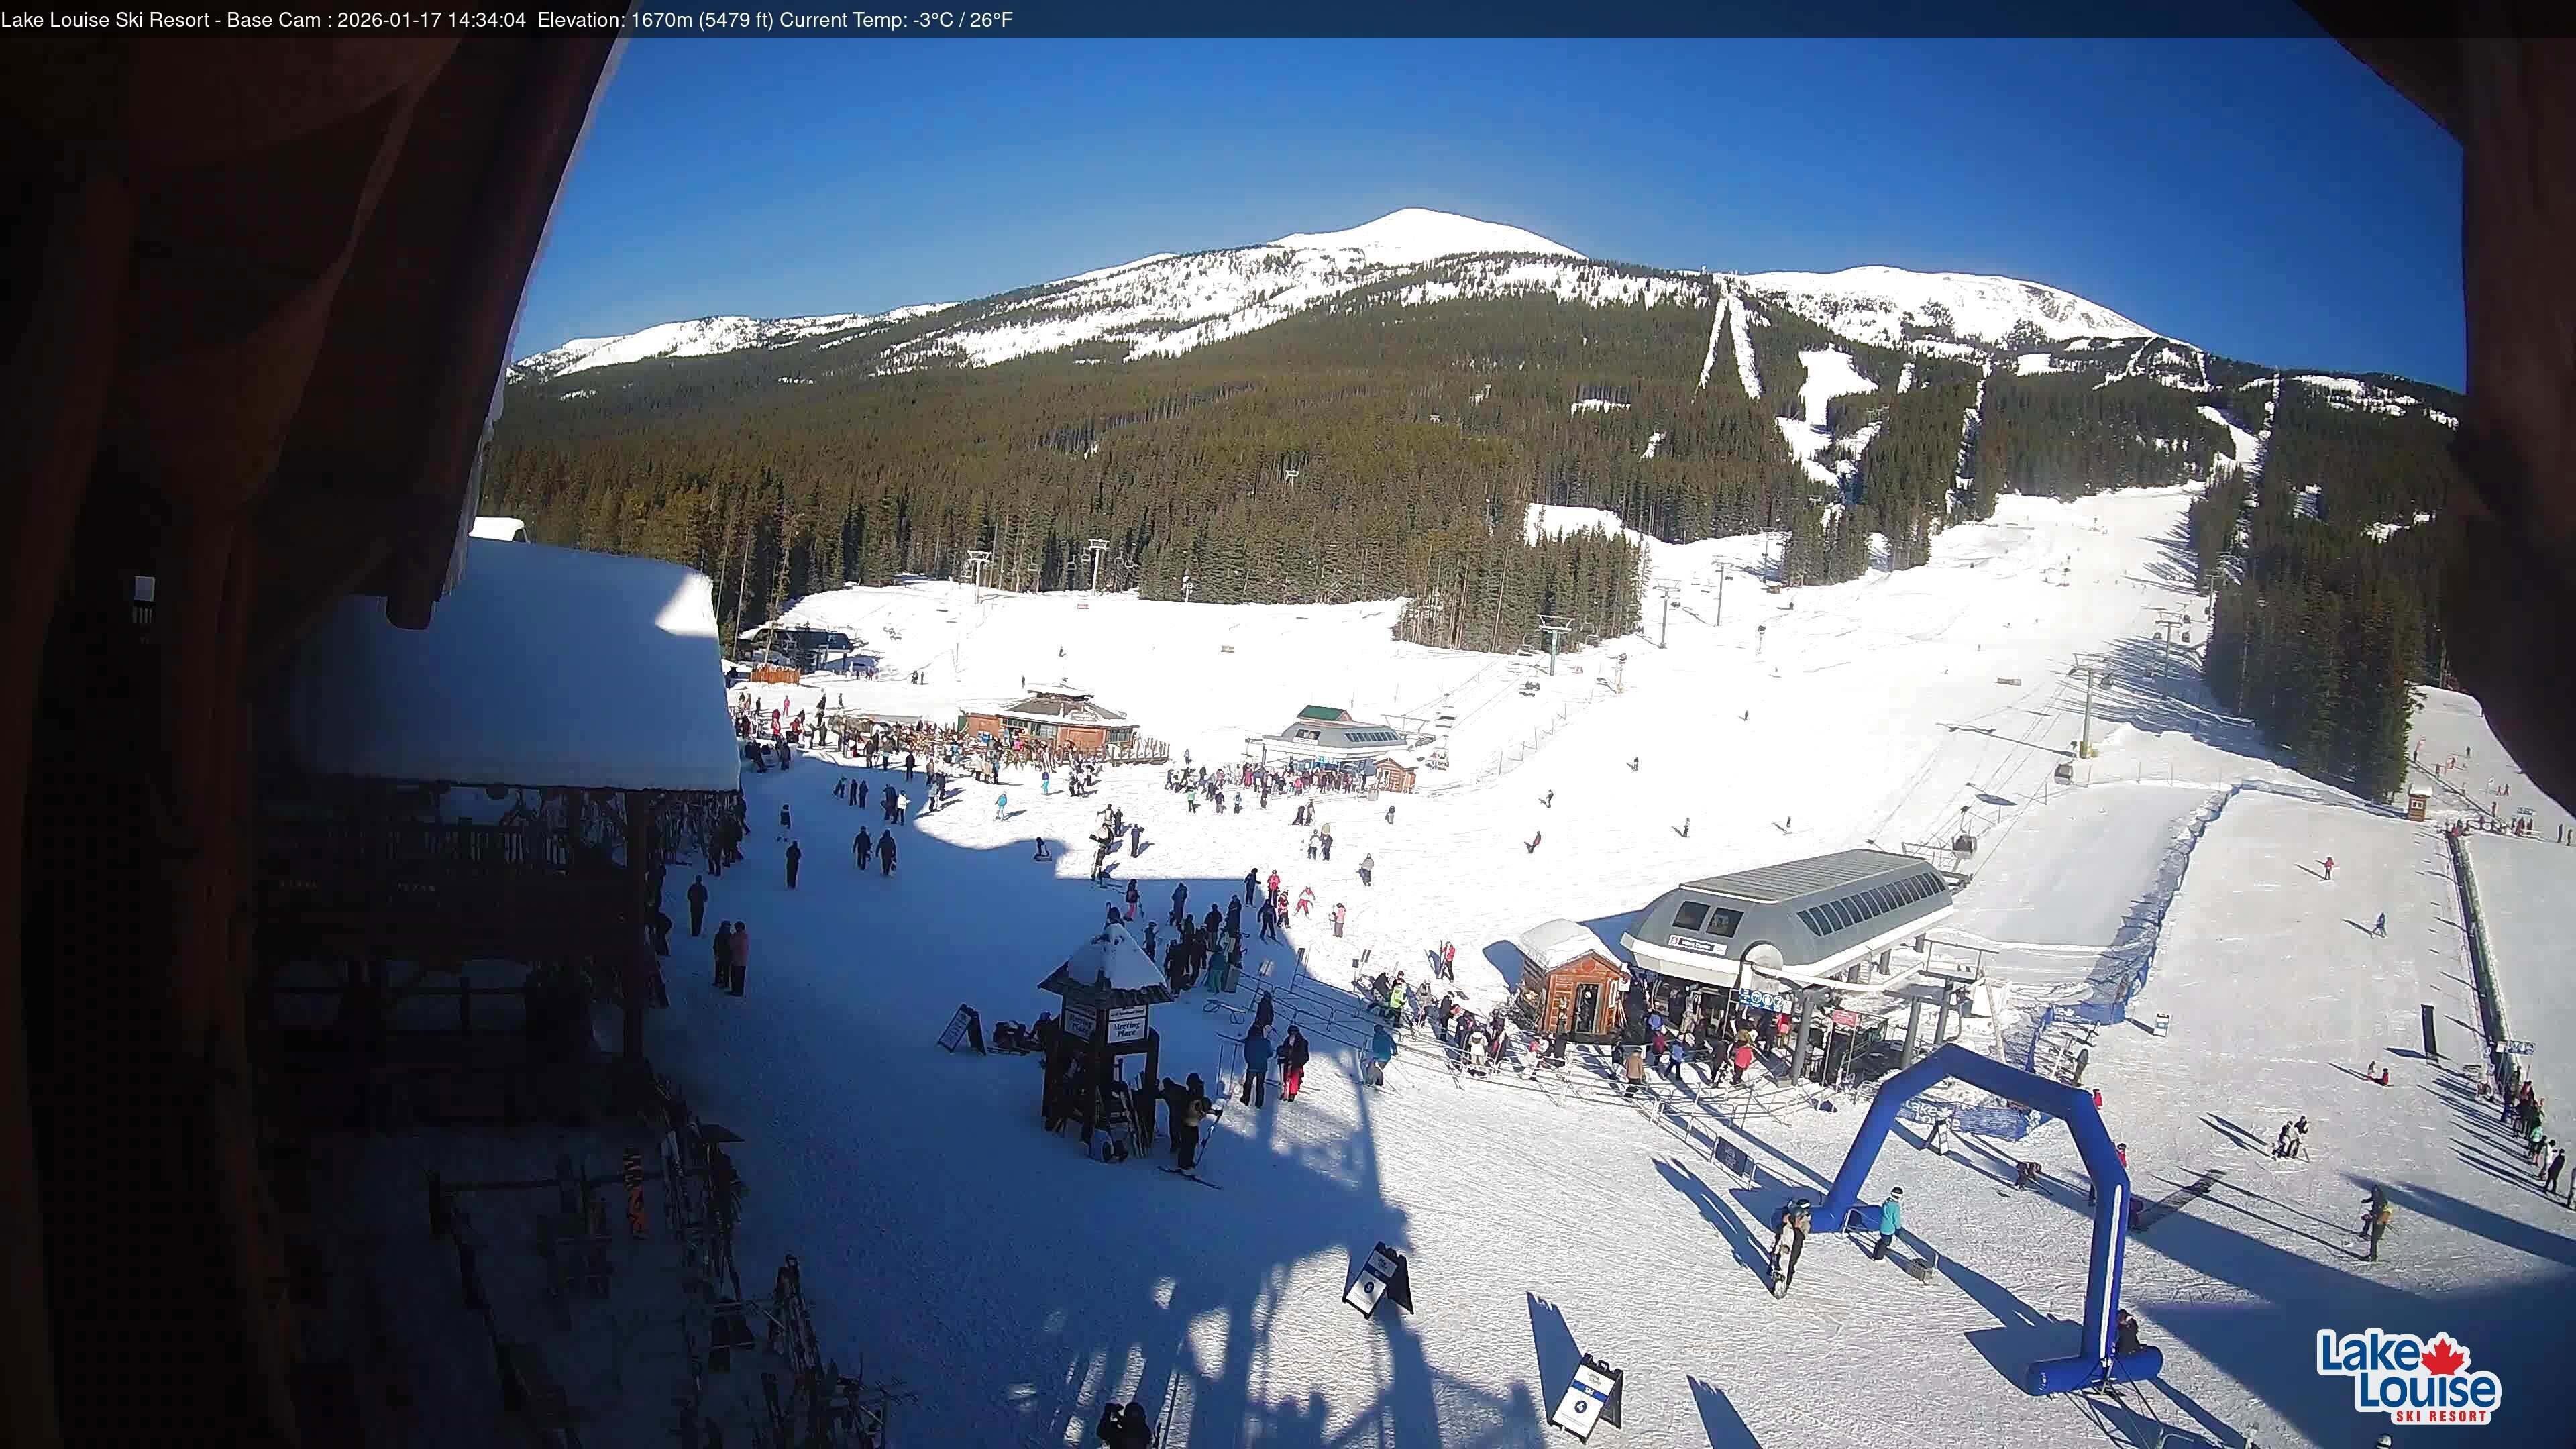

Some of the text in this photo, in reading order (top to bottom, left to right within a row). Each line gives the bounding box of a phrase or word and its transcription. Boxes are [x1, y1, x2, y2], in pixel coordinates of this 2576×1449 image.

[1114, 1021, 1140, 1030] Meeting
[1906, 1100, 1937, 1116] Lake
[1915, 1113, 1960, 1130] Louse
